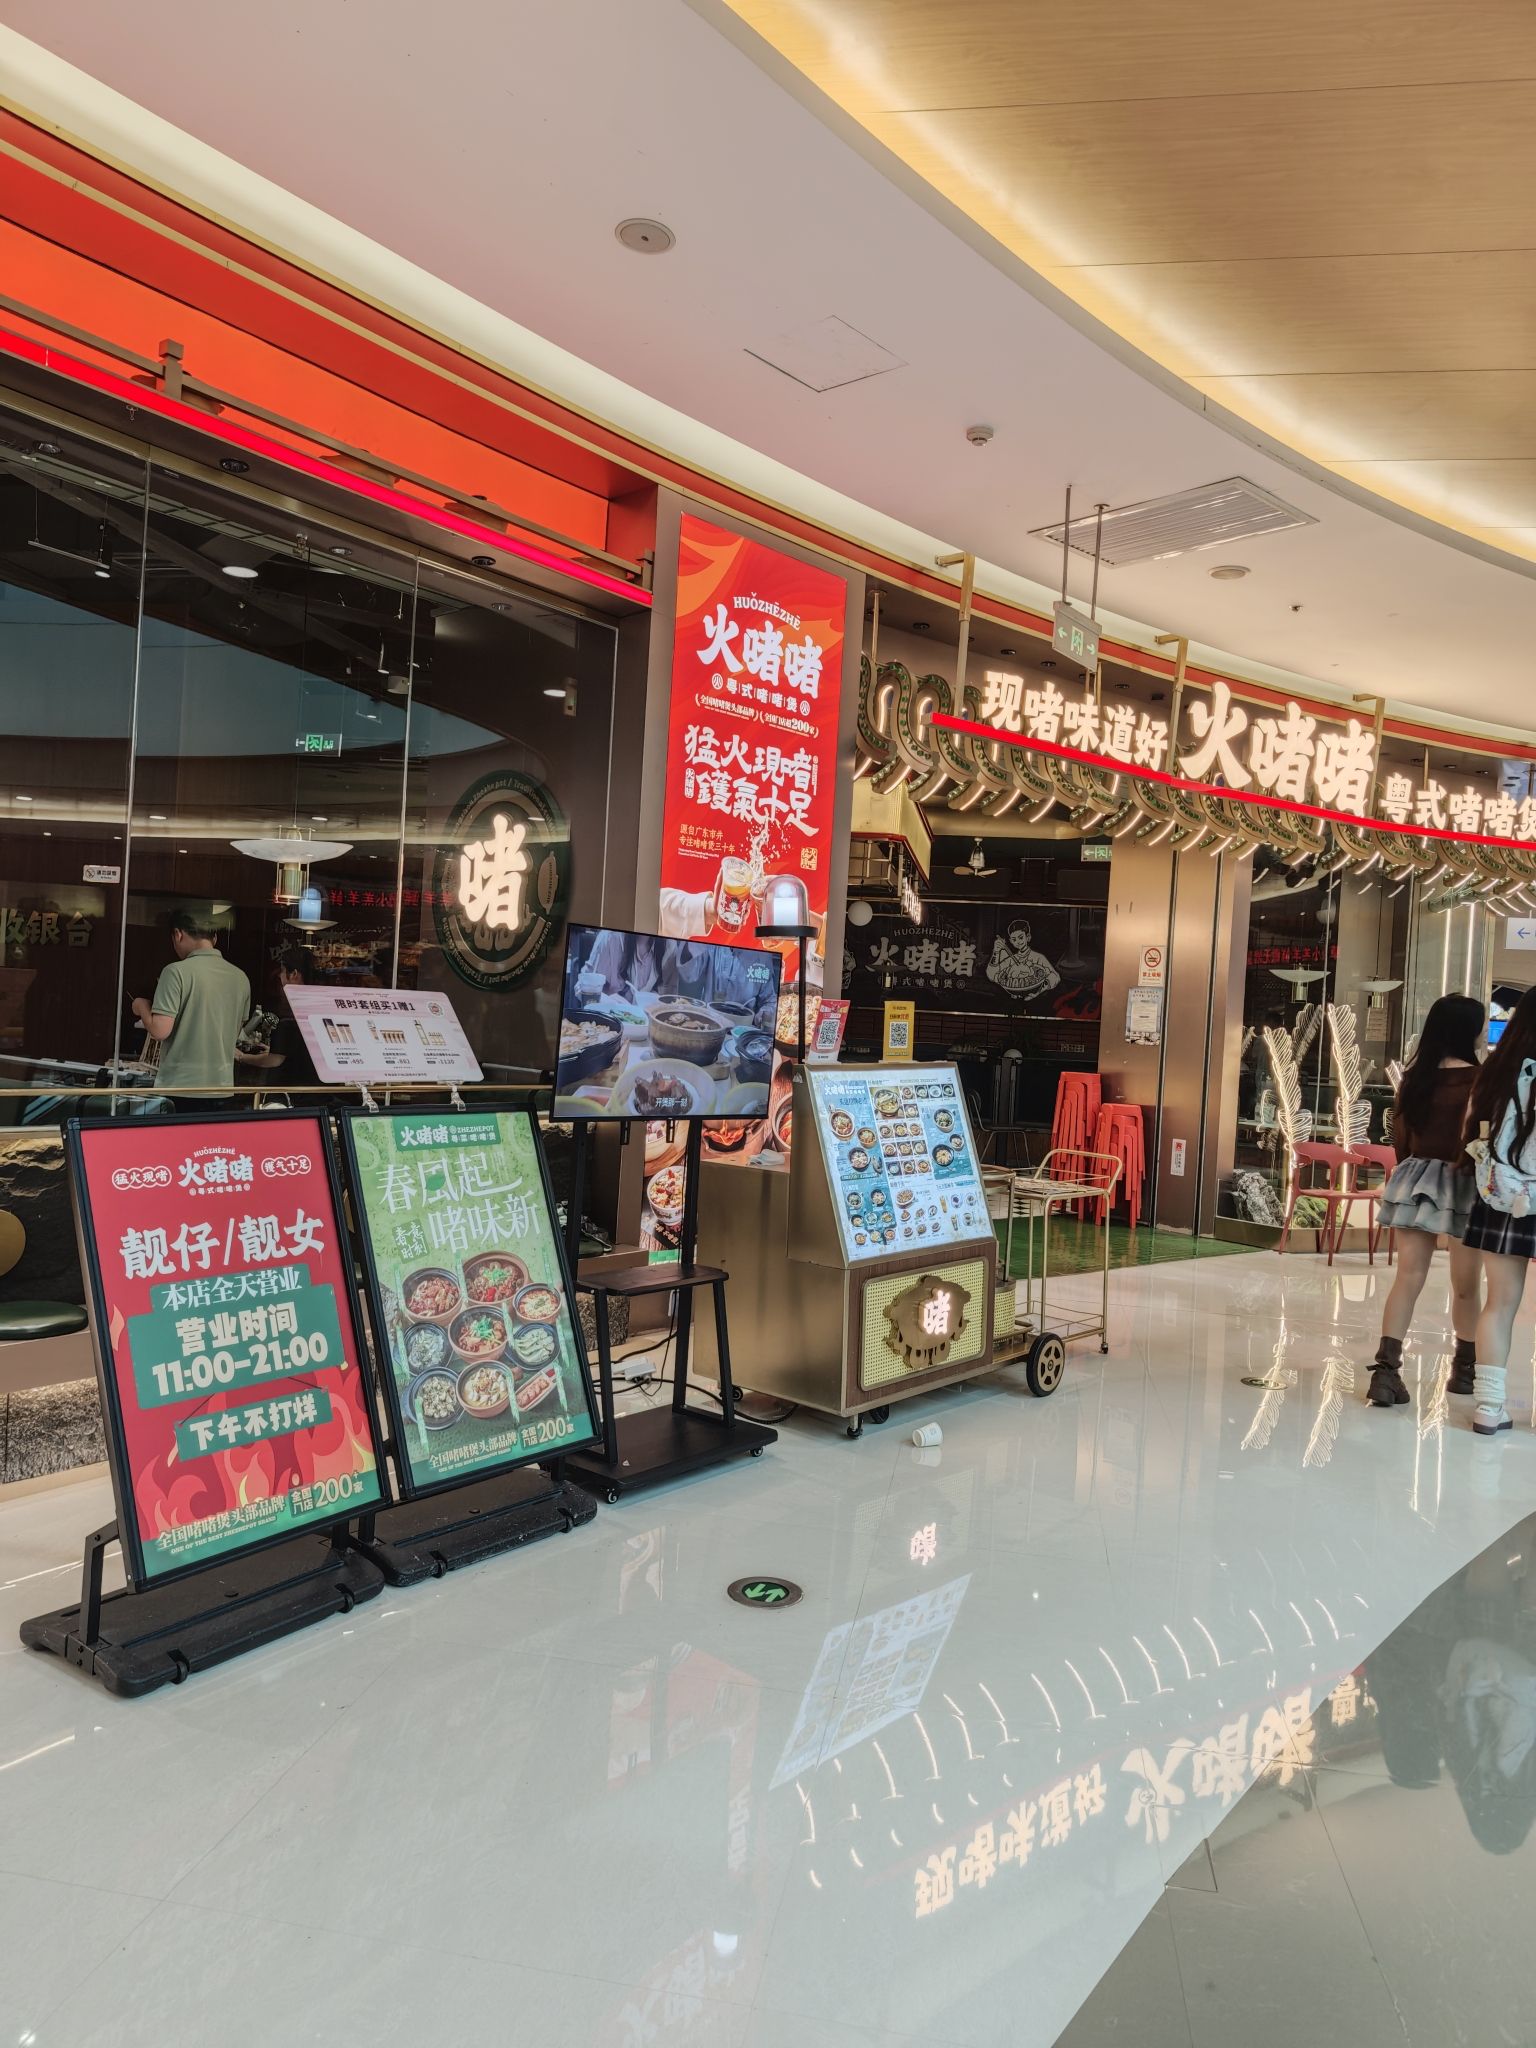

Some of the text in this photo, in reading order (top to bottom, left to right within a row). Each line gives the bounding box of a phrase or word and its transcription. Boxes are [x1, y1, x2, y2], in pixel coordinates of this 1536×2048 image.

[696, 603, 823, 699] 火啫啫
[982, 670, 1168, 772] 现啫味道好
[1180, 682, 1377, 818] 火啫啫
[459, 814, 527, 930] 啫
[401, 1124, 449, 1147] 火啫啫
[177, 1154, 254, 1187] 火啫啫
[119, 1209, 325, 1280] 靓仔/靓女
[162, 1266, 302, 1312] 本店全天营业
[176, 1303, 298, 1356] 营业时间
[190, 1393, 318, 1451] 下午不打烊
[157, 1495, 286, 1550] 全国啫啫煲头部品牌
